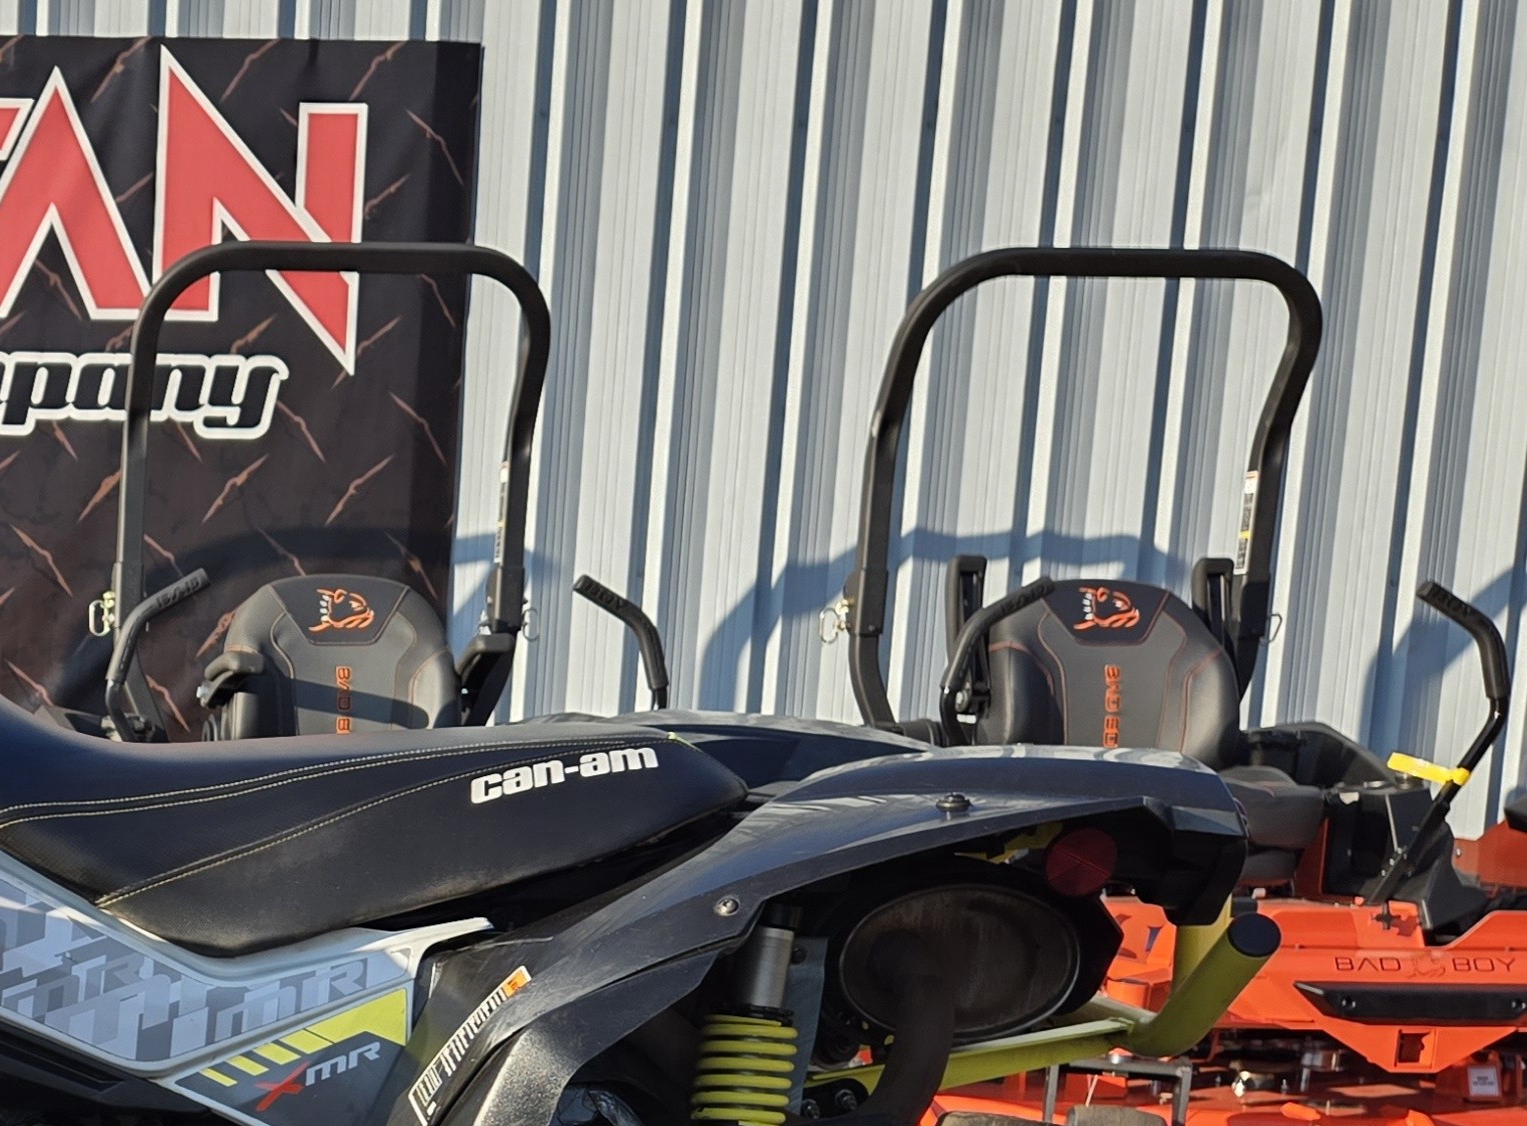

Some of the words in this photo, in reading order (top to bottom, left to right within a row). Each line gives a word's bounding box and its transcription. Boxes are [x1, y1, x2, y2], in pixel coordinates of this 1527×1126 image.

[1103, 715, 1120, 748] BO
[471, 747, 658, 804] can-am
[1335, 956, 1401, 972] BAD
[1452, 957, 1517, 972] BOY
